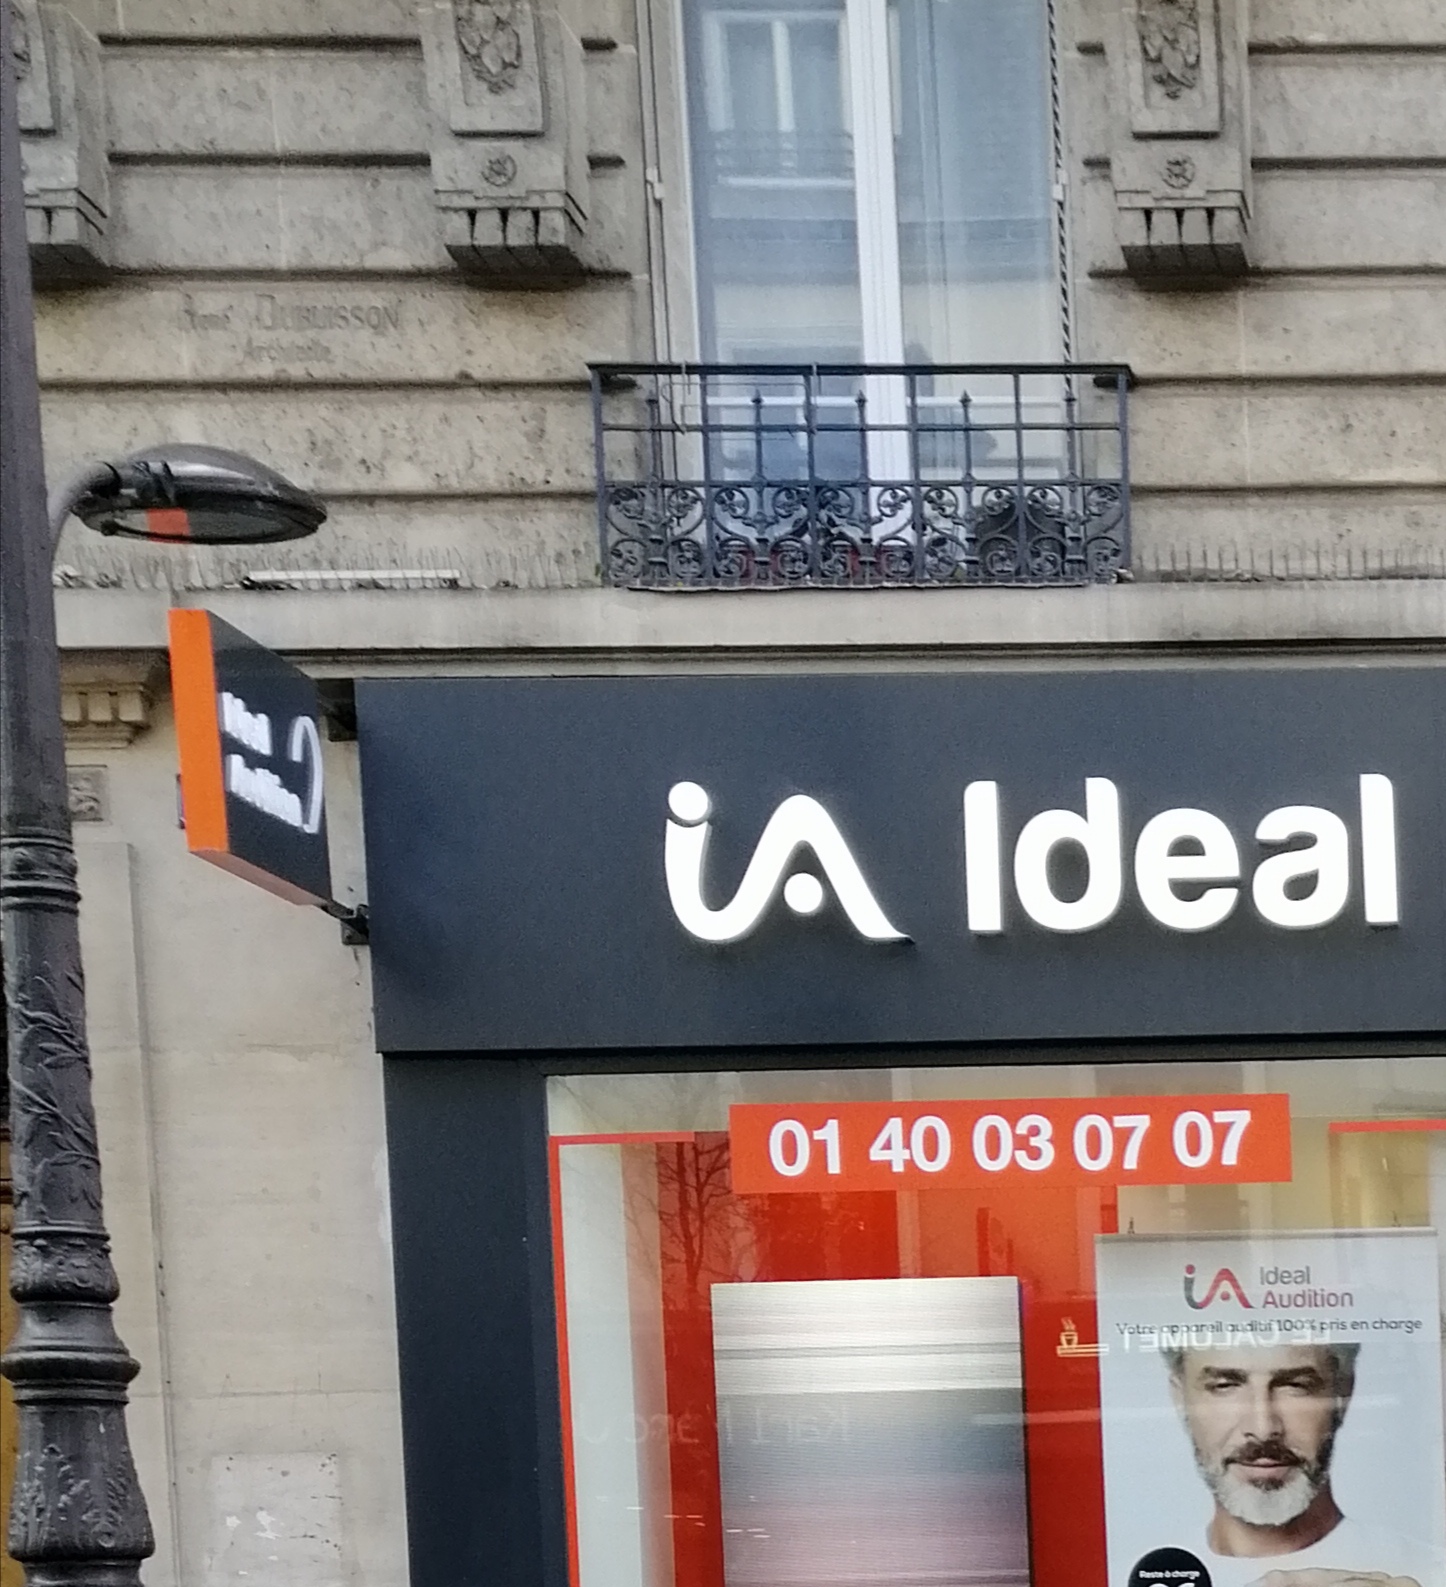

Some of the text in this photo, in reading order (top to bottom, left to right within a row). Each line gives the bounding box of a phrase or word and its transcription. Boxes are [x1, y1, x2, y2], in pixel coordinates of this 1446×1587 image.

[963, 772, 1400, 934] Ideal
[769, 1109, 1252, 1176] 01 40 03 07 07
[1260, 1266, 1311, 1286] Ideal
[1262, 1288, 1354, 1309] Audition
[1115, 1322, 1156, 1336] Votre
[1159, 1320, 1223, 1337] appareil
[1225, 1318, 1275, 1334] auditif
[1319, 1316, 1348, 1335] pris
[1350, 1320, 1370, 1331] en
[1372, 1317, 1424, 1335] charge
[1171, 1570, 1200, 1580] charge
